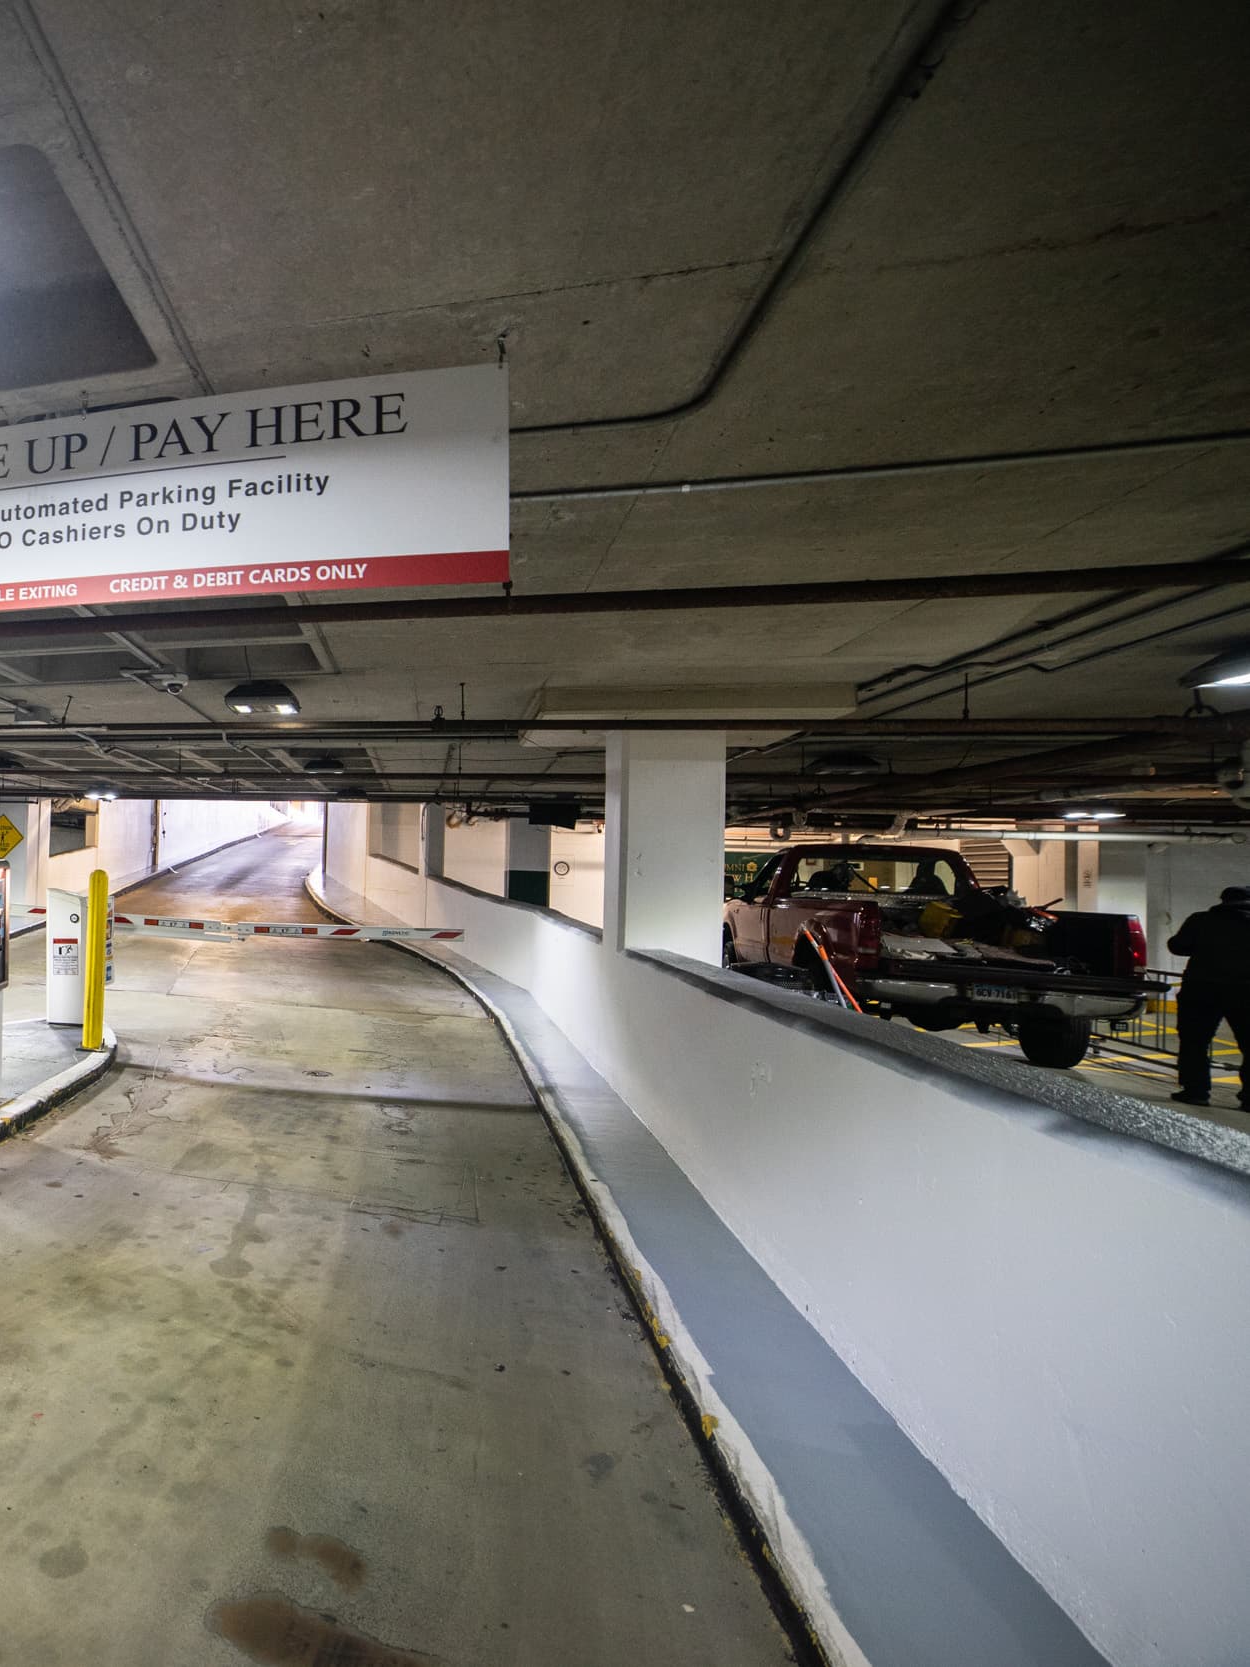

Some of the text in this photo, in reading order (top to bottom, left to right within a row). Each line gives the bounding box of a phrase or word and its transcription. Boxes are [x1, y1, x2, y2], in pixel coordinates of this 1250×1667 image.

[27, 432, 88, 475] UP
[100, 426, 116, 466] /
[129, 412, 232, 463] PAY
[246, 392, 409, 449] HERE
[119, 484, 216, 510] Parking
[228, 473, 330, 498] Facility
[21, 522, 126, 548] Cashiers
[137, 516, 170, 536] On
[181, 511, 241, 534] Duty
[18, 583, 78, 601] EXITING
[109, 563, 368, 594] CREDIT & DEBIT CARDS ONLY
[724, 864, 745, 872] MNI
